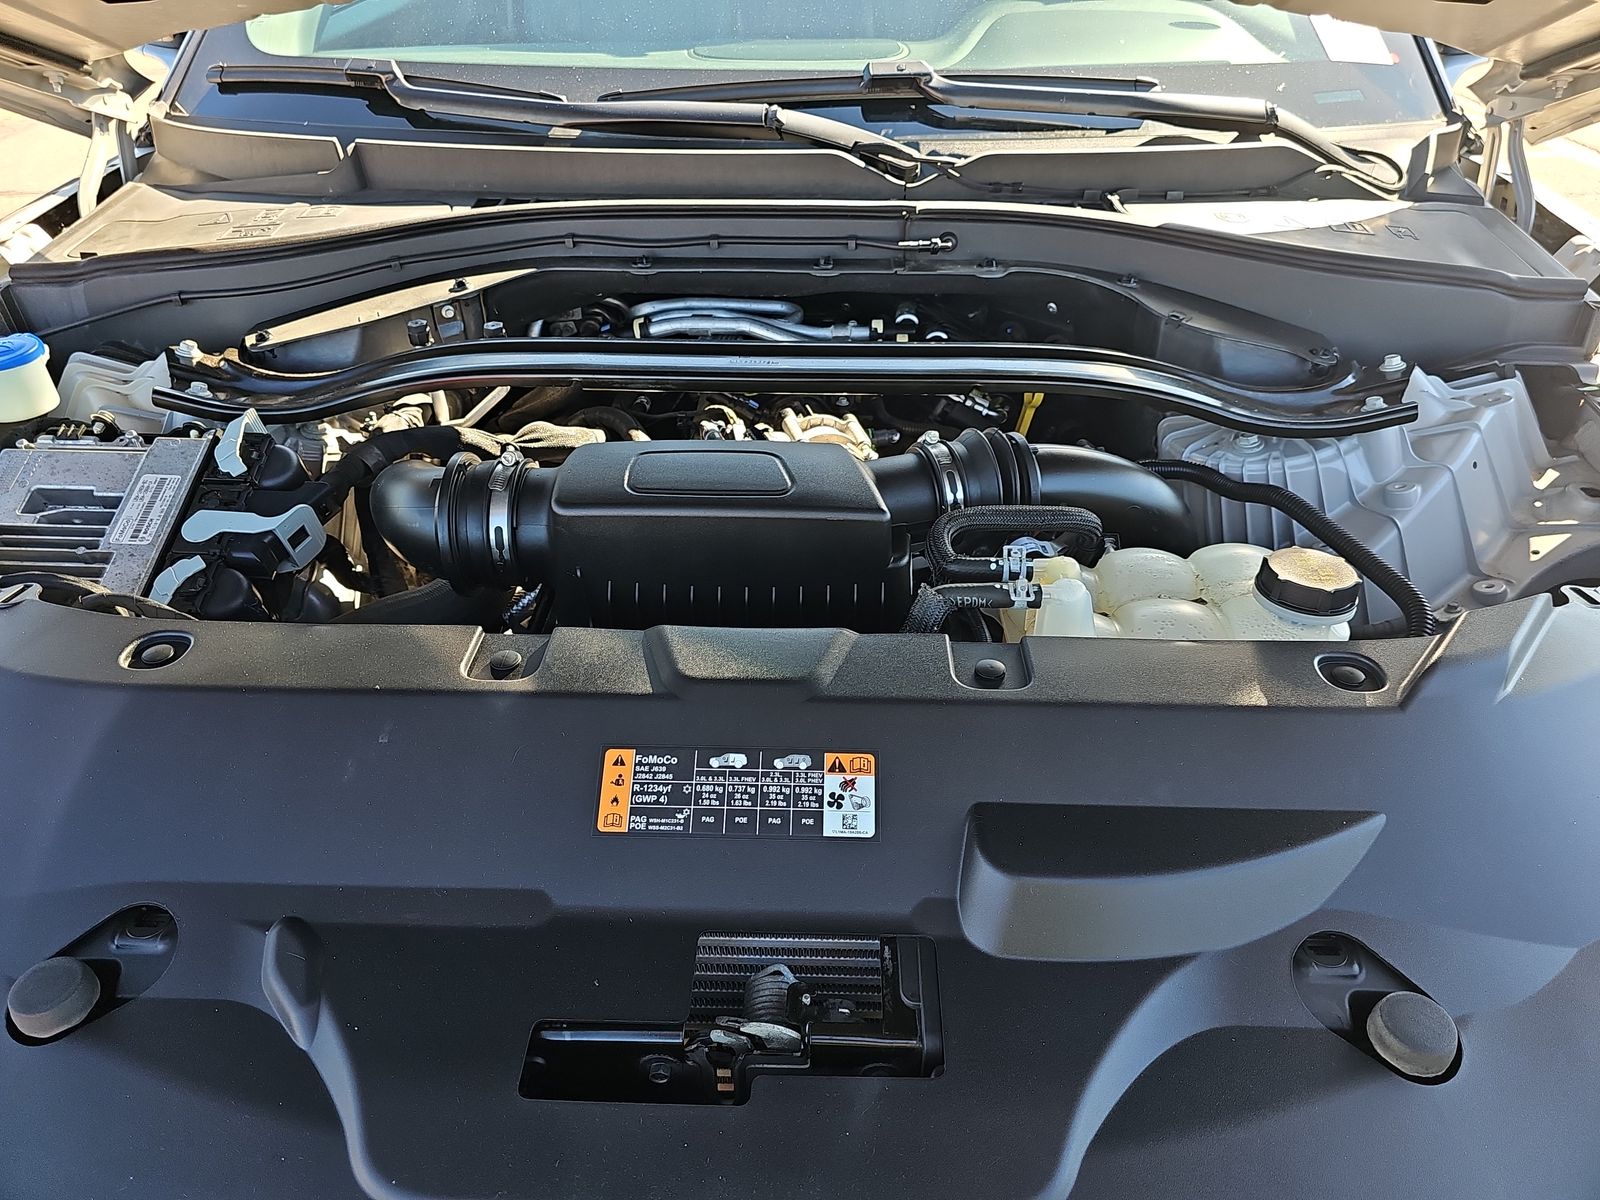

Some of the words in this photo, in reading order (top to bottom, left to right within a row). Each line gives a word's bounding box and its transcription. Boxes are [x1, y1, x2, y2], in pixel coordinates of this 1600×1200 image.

[142, 518, 154, 535] BOSCH
[636, 754, 678, 764] FoMoCo
[633, 784, 672, 794] R-1234yf
[714, 785, 723, 794] kg
[747, 786, 756, 794] kg
[782, 786, 790, 794] kg
[813, 787, 822, 796] kg
[632, 795, 658, 804] (GWP
[658, 795, 668, 804] 4)
